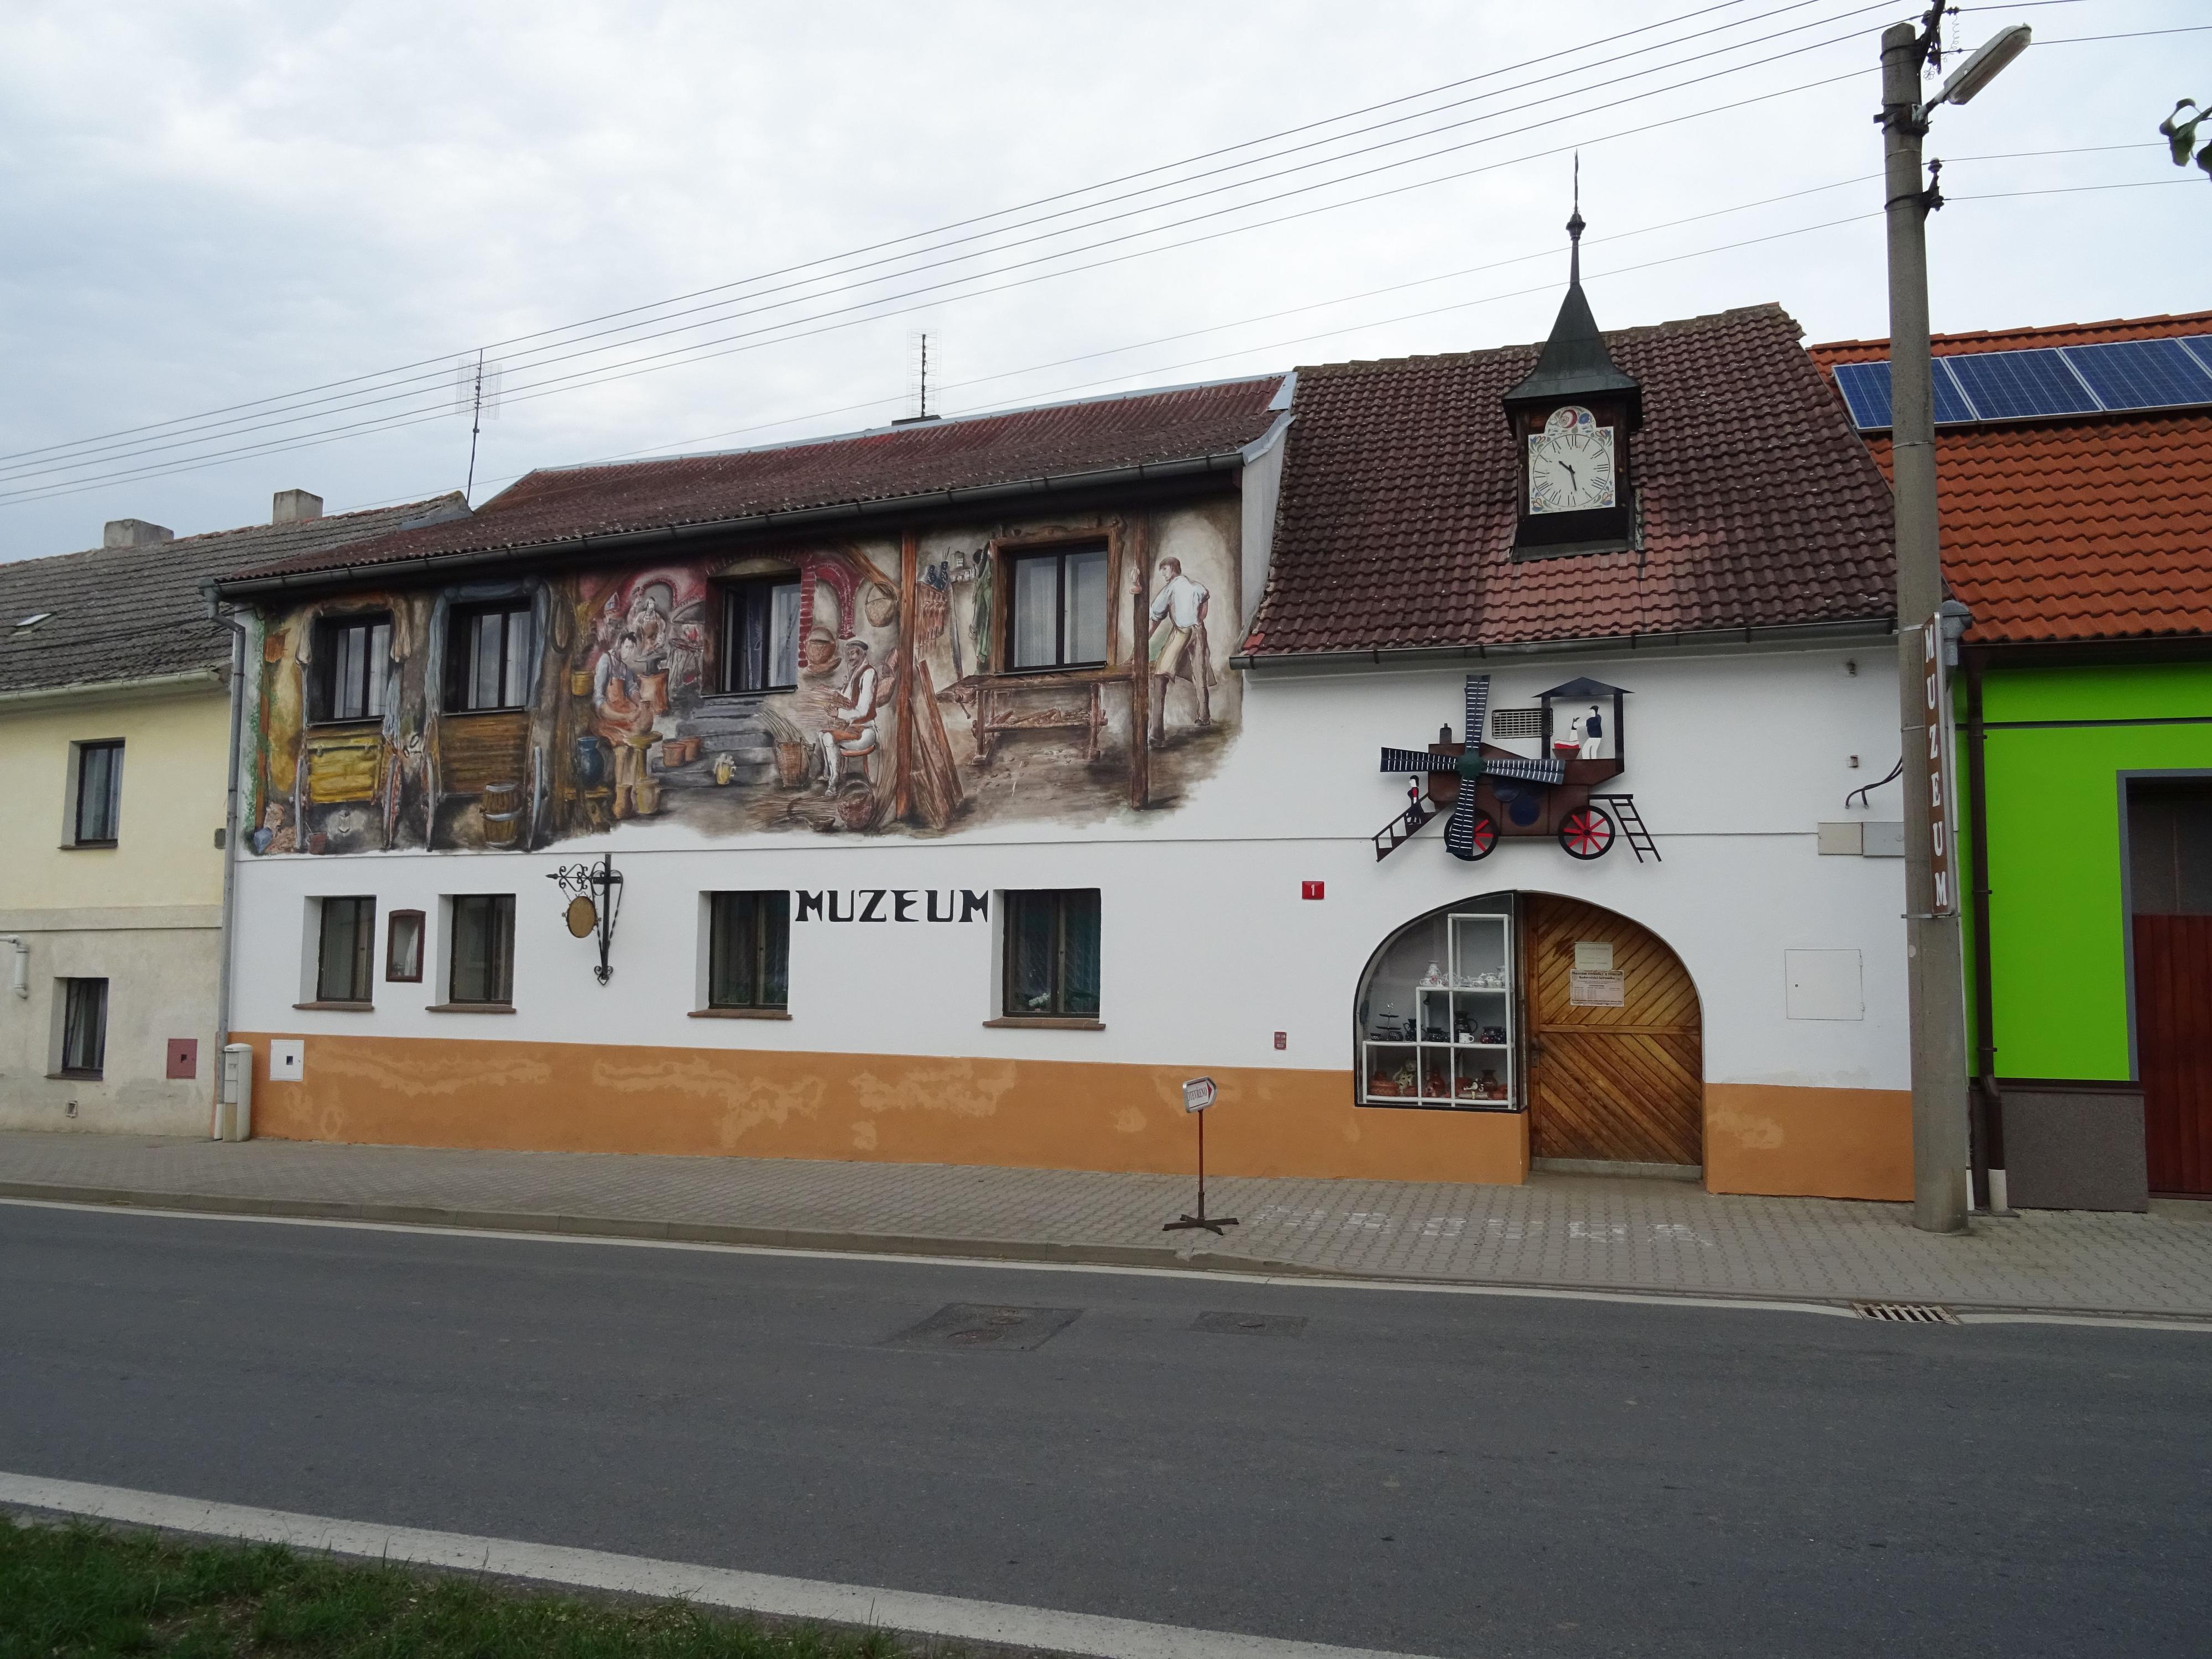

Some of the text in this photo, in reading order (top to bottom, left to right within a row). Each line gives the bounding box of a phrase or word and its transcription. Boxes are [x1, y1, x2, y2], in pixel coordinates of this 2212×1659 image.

[1924, 624, 1948, 906] MUZEUM
[1311, 884, 1315, 896] 1
[795, 889, 989, 922] MUZEUM
[1186, 1087, 1207, 1102] OTEVŘENO
